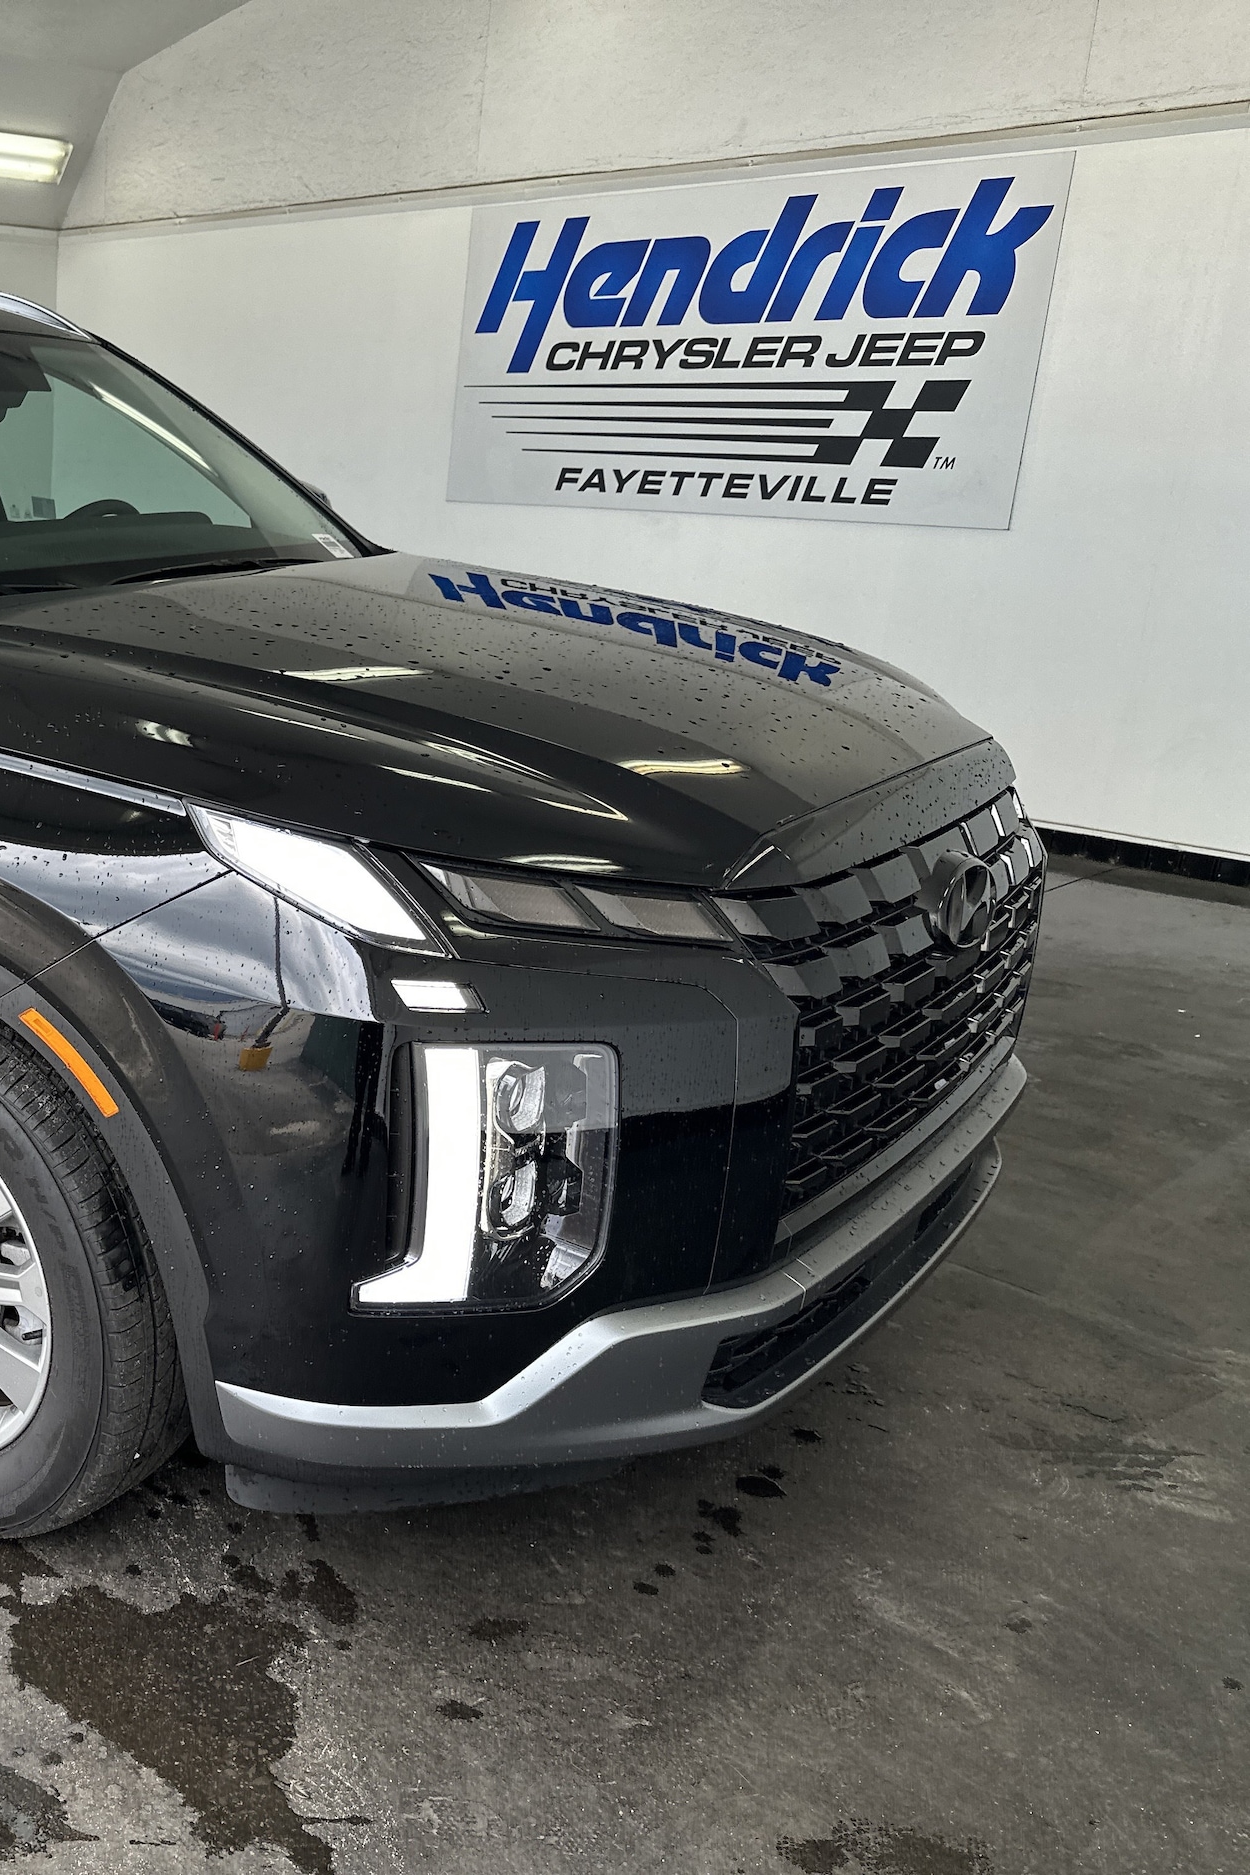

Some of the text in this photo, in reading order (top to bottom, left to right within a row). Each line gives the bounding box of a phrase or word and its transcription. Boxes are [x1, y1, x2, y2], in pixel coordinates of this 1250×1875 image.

[475, 177, 1054, 373] Hendrick
[546, 331, 986, 371] CHRYSLER JEEP
[933, 456, 956, 470] TM
[555, 467, 898, 506] FAYETTEVILLE
